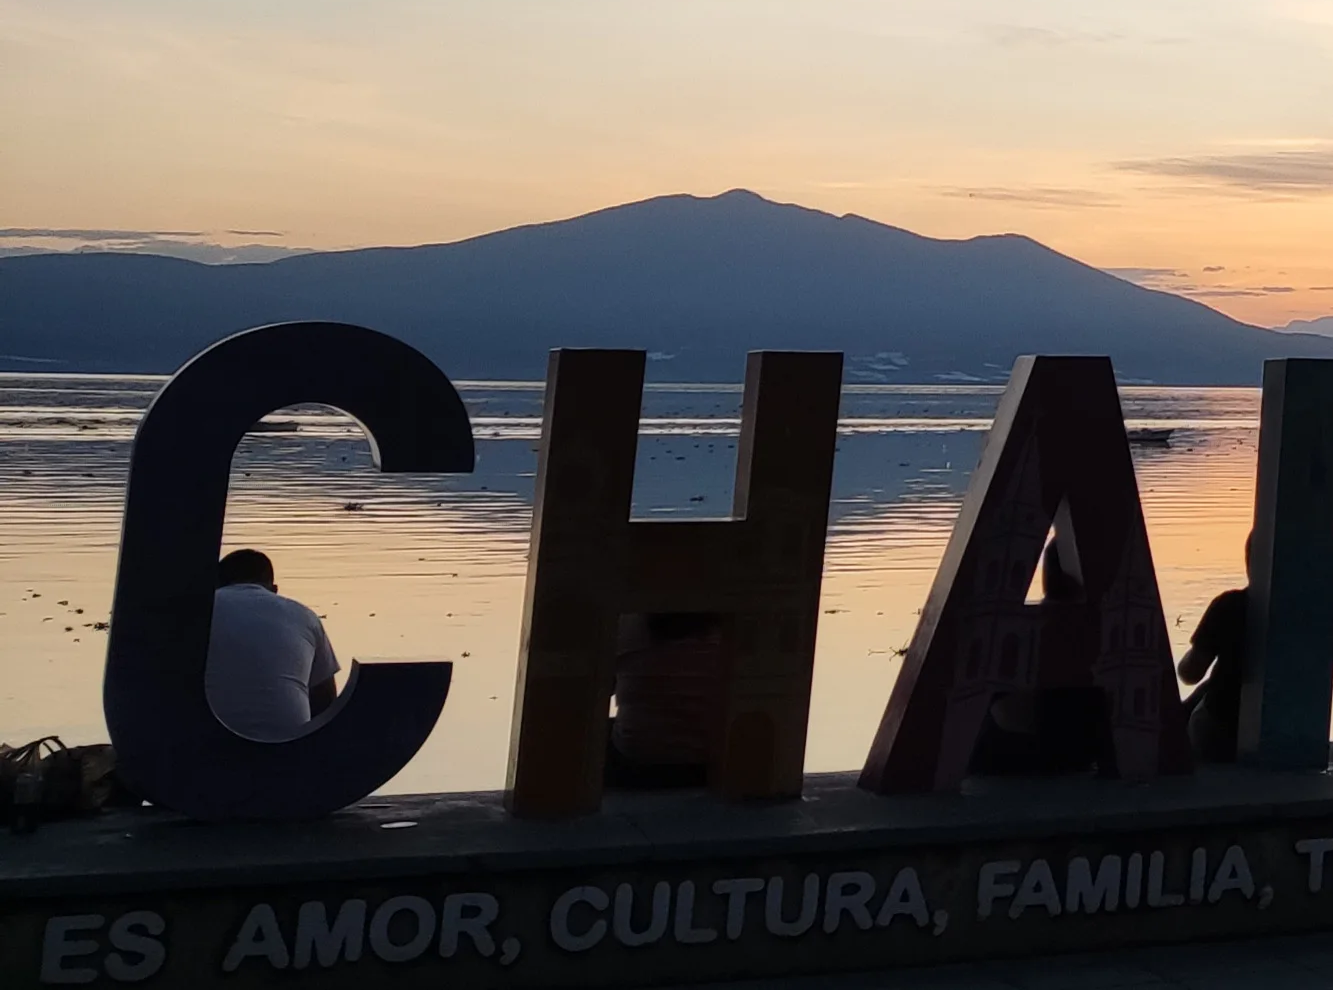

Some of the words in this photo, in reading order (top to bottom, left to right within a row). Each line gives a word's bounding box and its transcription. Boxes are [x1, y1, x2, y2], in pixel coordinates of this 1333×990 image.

[40, 909, 167, 985] ES
[222, 891, 520, 971] AMOR,
[550, 867, 950, 952] CULTURA,
[976, 844, 1273, 922] FAMILIA,
